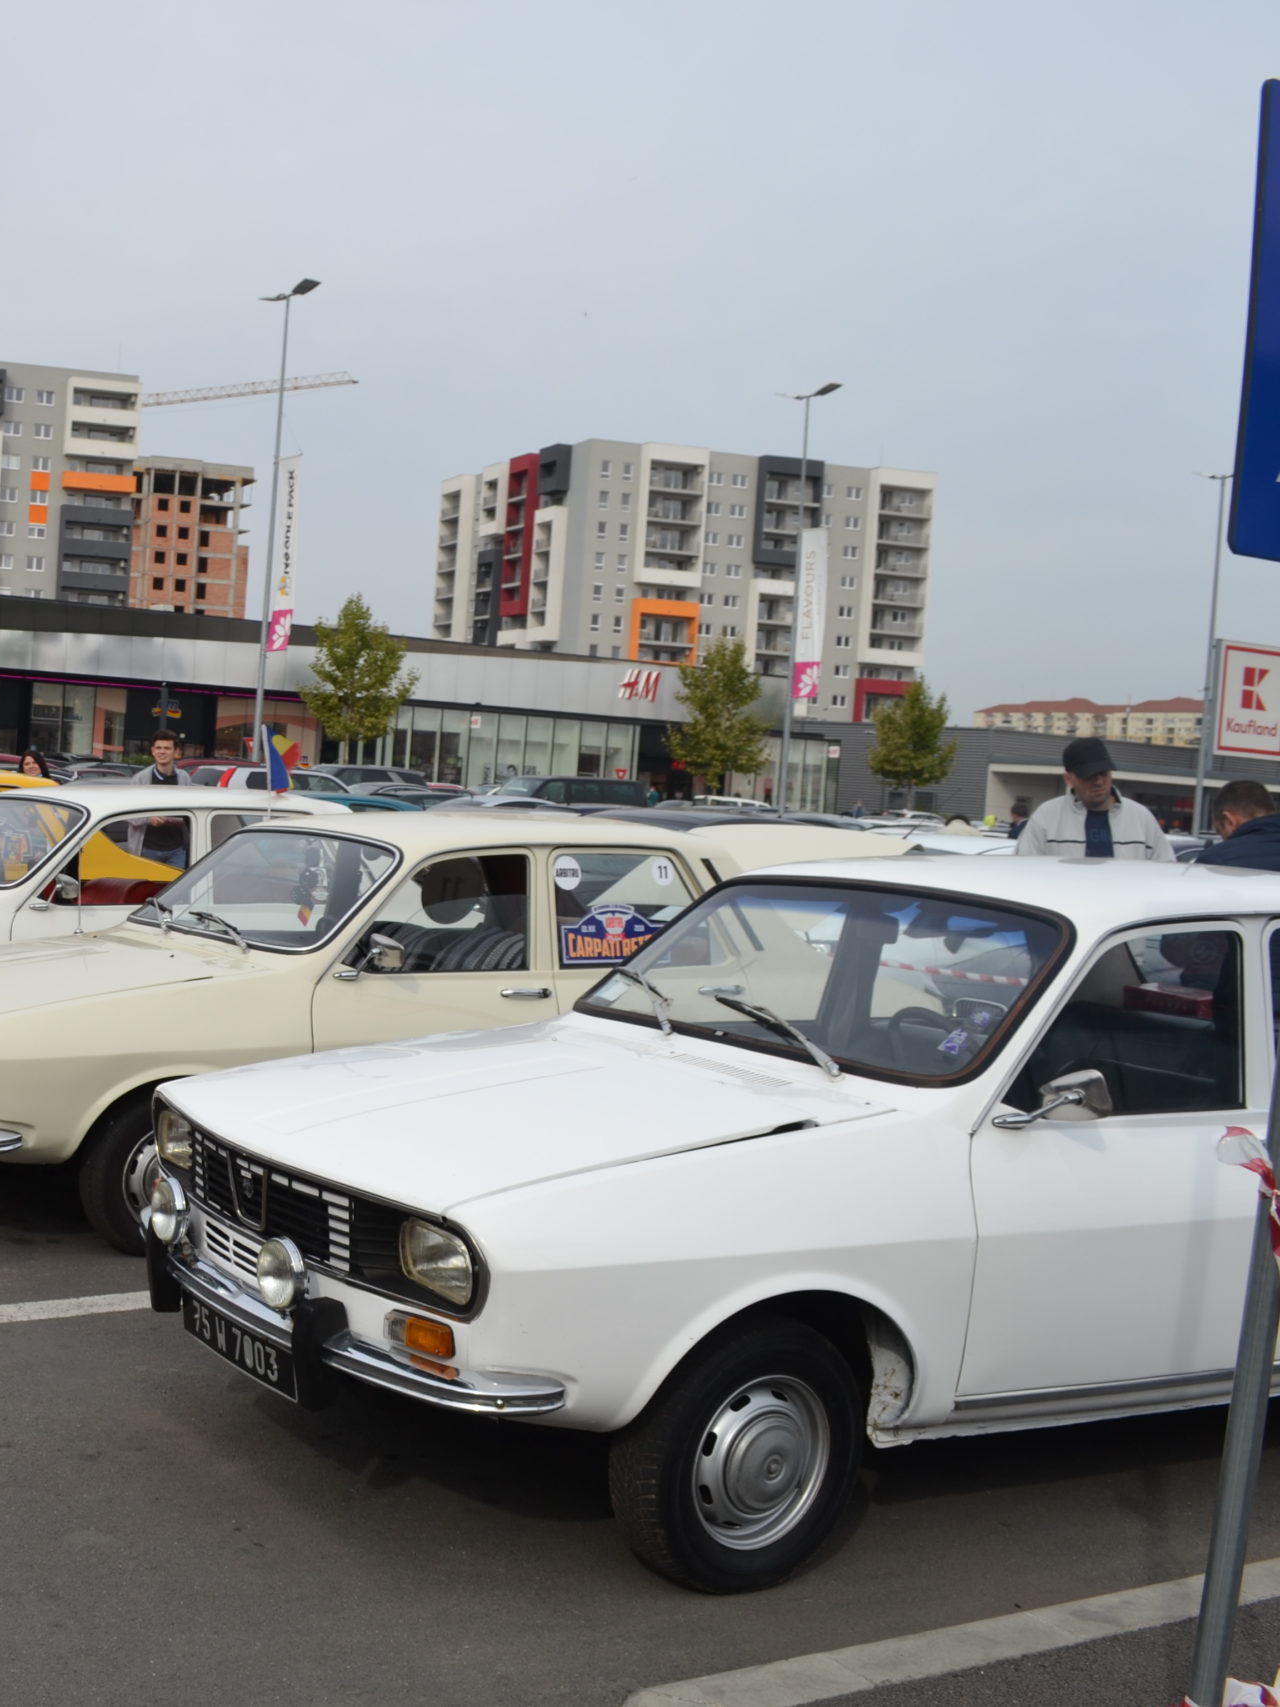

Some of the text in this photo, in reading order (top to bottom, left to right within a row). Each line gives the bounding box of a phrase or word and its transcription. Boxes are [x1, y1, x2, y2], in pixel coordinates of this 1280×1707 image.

[287, 469, 296, 508] PACK
[801, 550, 817, 641] FLAVOURS
[1226, 717, 1278, 737] Kaufland
[657, 865, 669, 879] 11
[567, 932, 621, 958] CARPATI
[192, 1300, 210, 1340] 75
[231, 1326, 279, 1382] 7003
